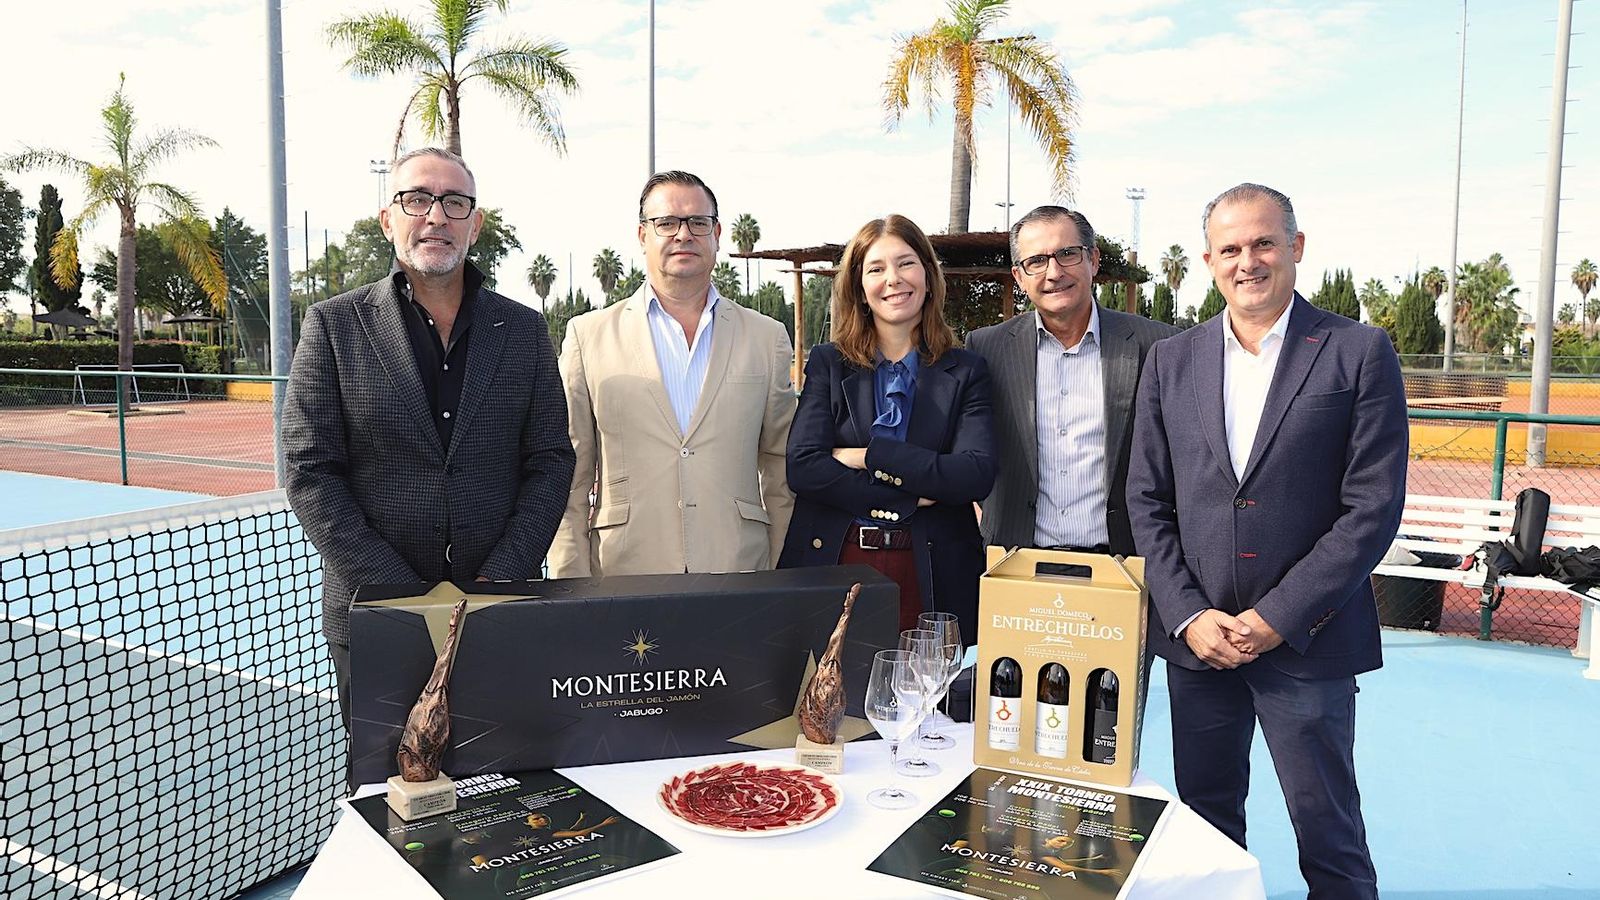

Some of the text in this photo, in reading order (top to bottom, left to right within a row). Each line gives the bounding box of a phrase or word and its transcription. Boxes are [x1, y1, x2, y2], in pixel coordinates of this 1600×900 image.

[1029, 607, 1056, 615] MIGUEL
[992, 614, 1125, 641] ENTRECHUELOS
[551, 667, 728, 698] MONTESIERRA
[596, 697, 644, 708] ESTRELLA
[646, 696, 664, 704] DEL
[666, 692, 701, 702] JAMÓN
[619, 707, 663, 718] JABUGO
[455, 773, 504, 789] ORNEO
[1015, 779, 1054, 792] XXIX
[1056, 785, 1116, 804] TORNEO
[1007, 785, 1117, 813] MONTESIERRA
[469, 831, 605, 873] MONTESIERRA
[940, 843, 1078, 880] MONTESIERRA
